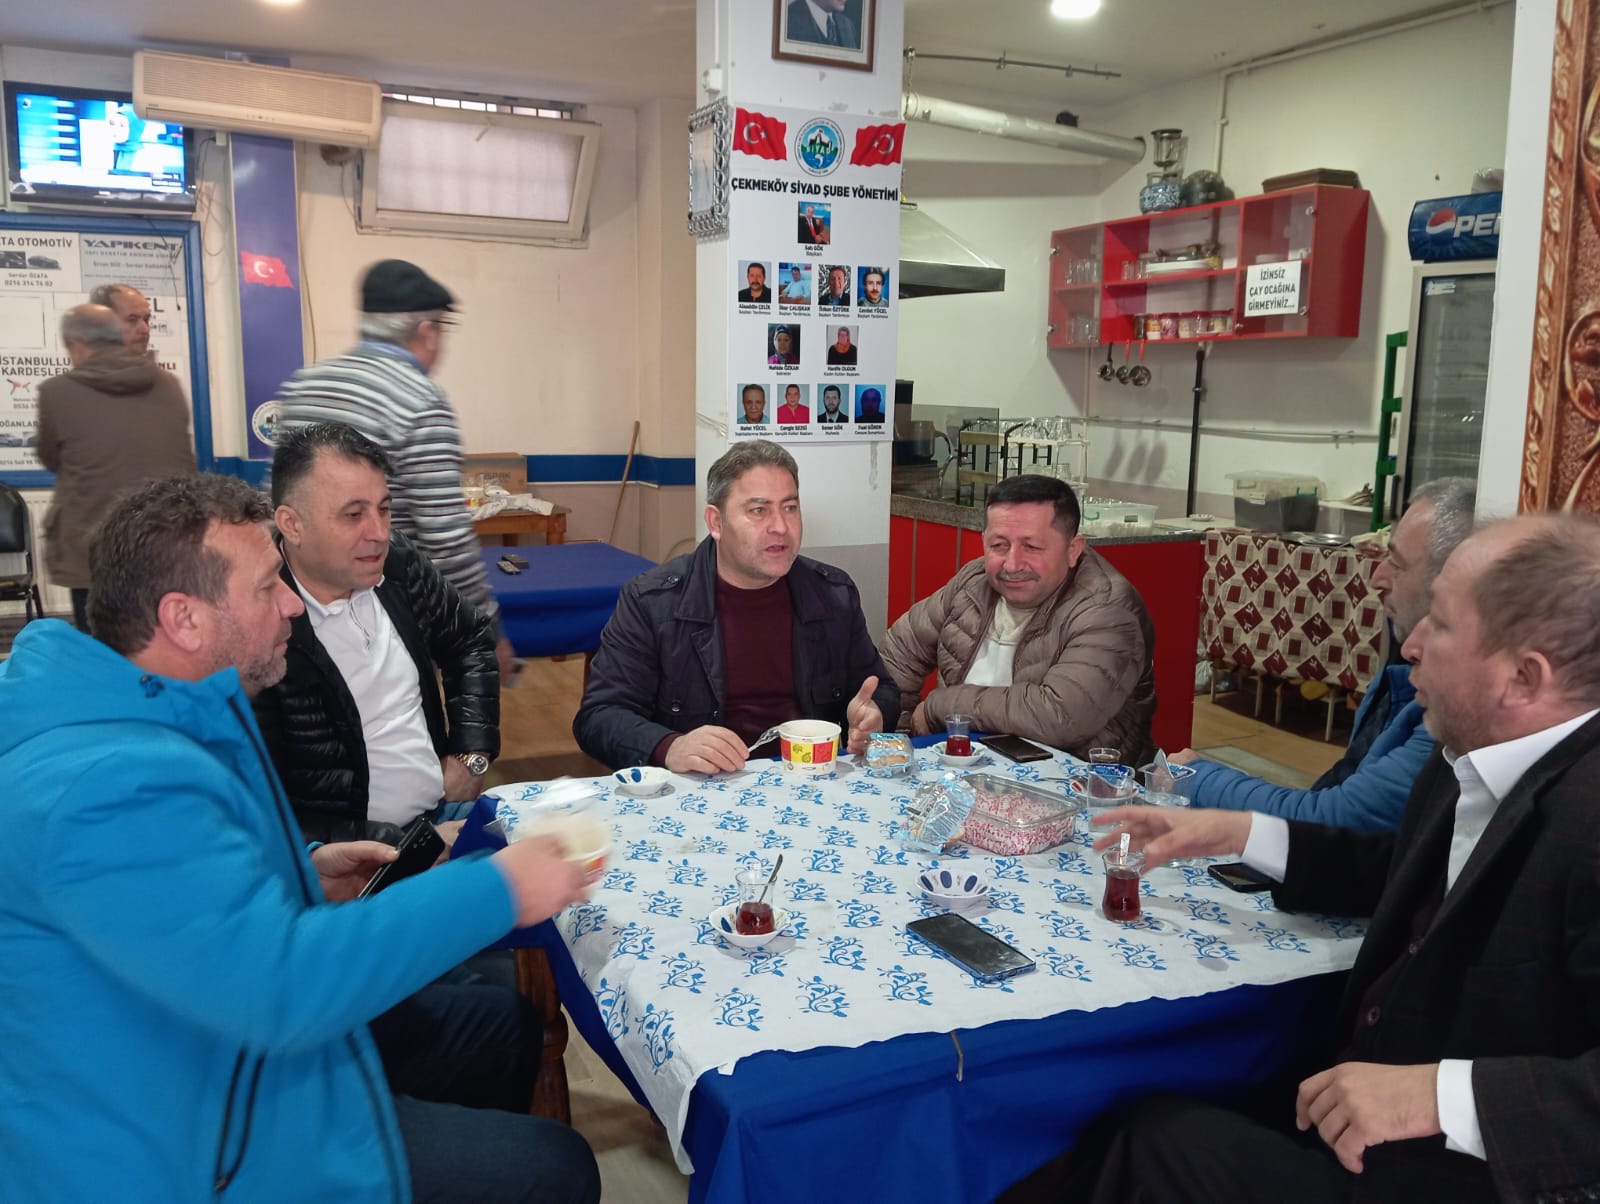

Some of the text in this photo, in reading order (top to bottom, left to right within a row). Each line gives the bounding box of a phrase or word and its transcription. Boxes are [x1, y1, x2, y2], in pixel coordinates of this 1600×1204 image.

[731, 177, 898, 201] ÇEKMEKÖY SİYAD ŞUBE YÖNETİMİ
[18, 237, 72, 248] OTOMOTİV
[84, 239, 179, 251] YAPIKENT
[1260, 266, 1286, 281] İZİNSİZ
[1250, 282, 1296, 297] ÇAY OCAĞINA
